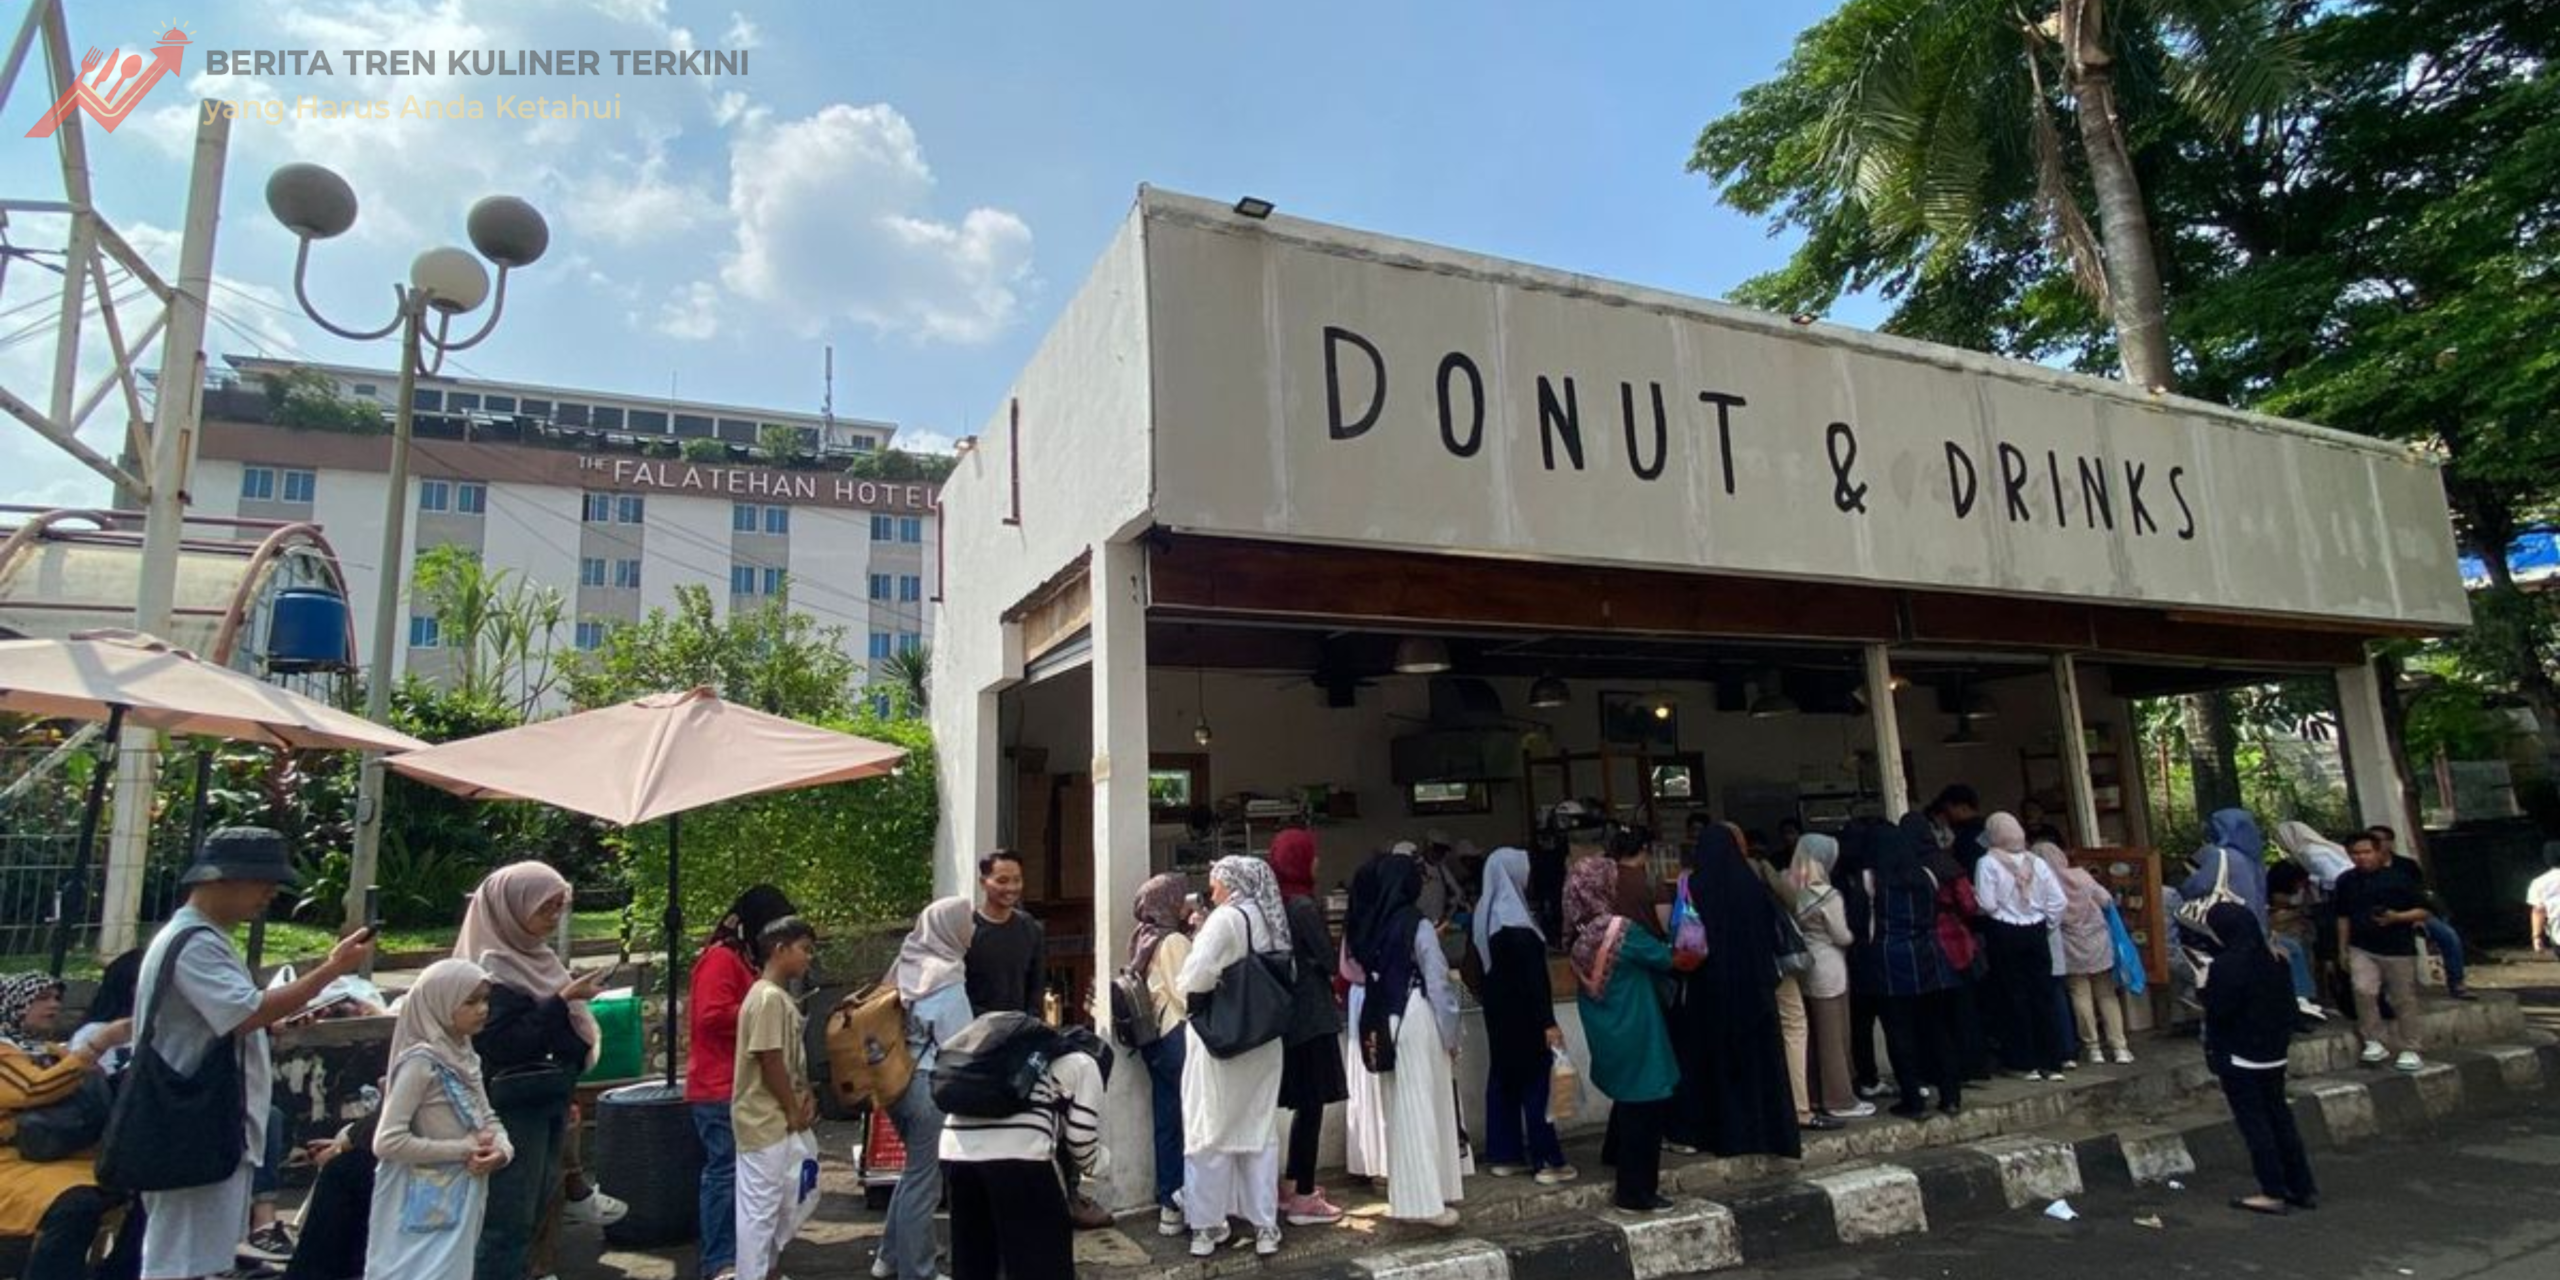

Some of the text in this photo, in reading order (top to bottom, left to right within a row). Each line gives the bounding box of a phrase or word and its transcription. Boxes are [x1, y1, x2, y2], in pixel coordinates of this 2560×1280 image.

[578, 456, 938, 510] THE FALATEHAN HOTEL
[1323, 326, 2195, 540] DONUT & DRINKS
